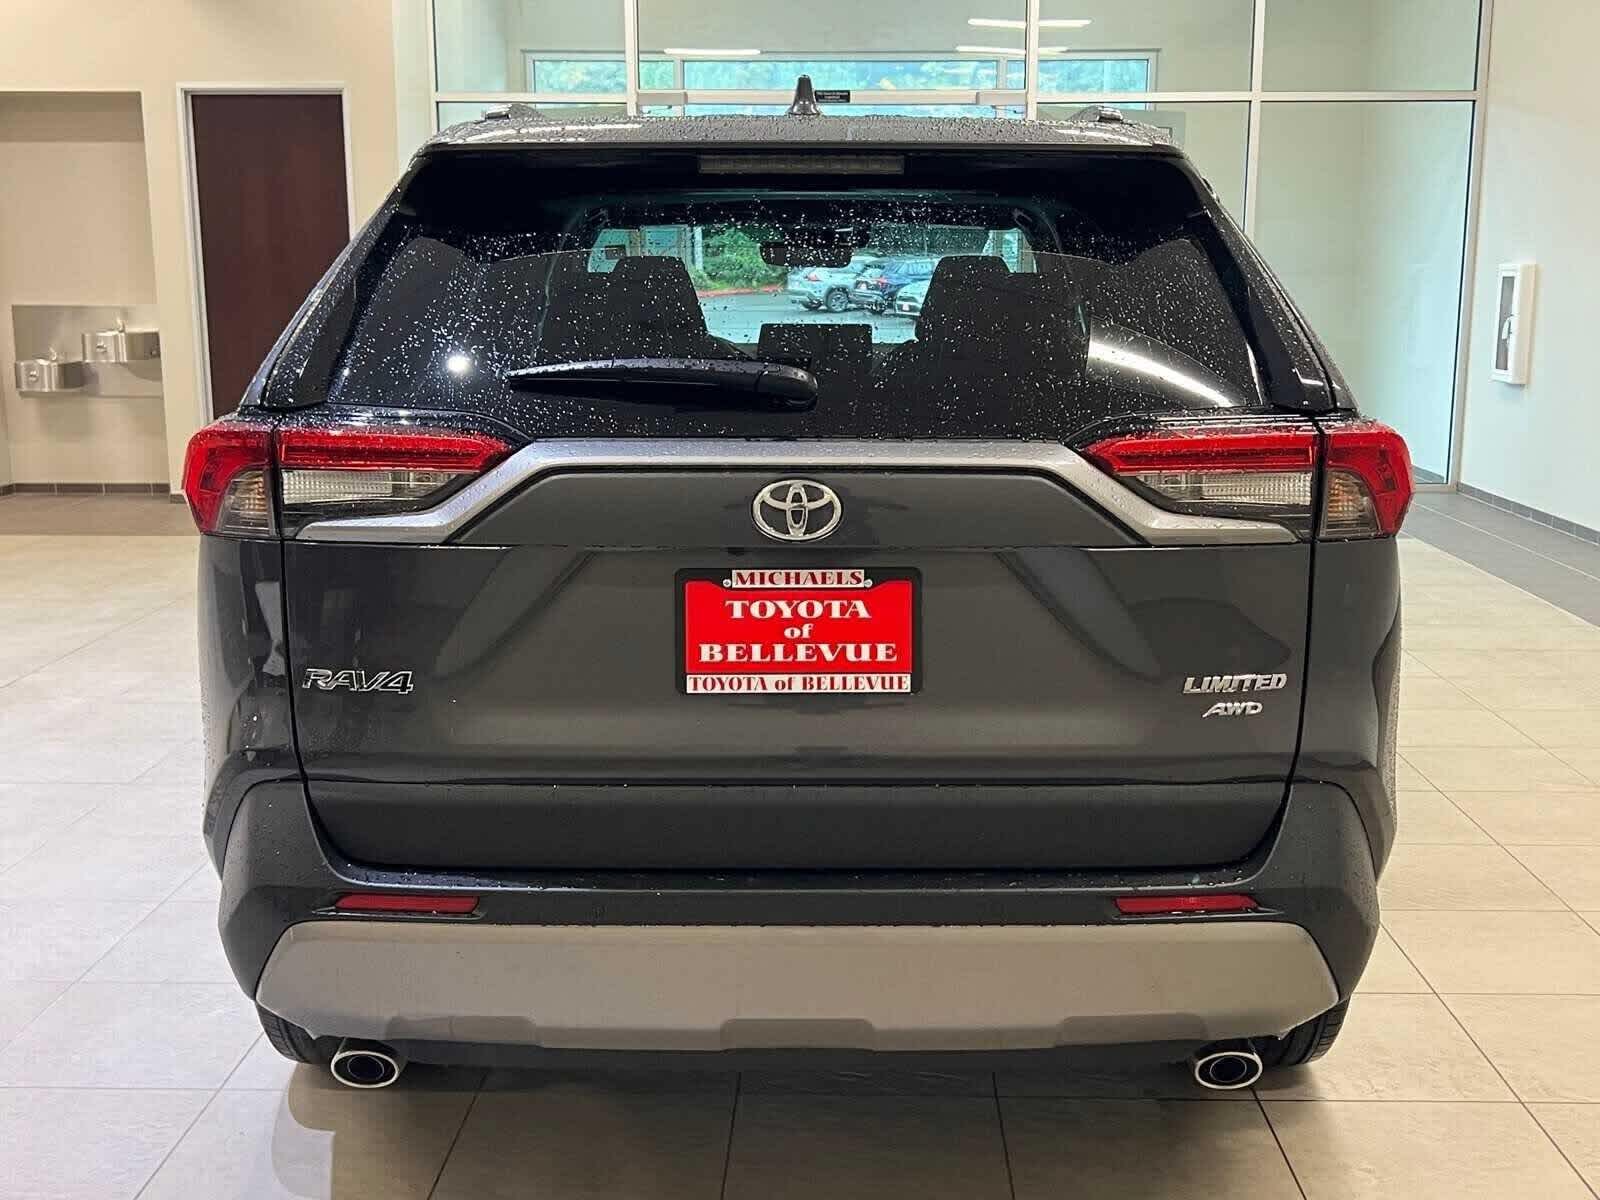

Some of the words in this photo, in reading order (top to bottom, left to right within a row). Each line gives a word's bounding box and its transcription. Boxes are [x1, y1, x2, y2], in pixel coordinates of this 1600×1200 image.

[735, 570, 863, 586] MICHAELS
[725, 600, 872, 619] TOYOTA
[783, 623, 815, 639] of
[698, 643, 898, 662] BELLEVUE
[302, 668, 414, 694] RAV4
[689, 676, 768, 691] TOYOTA
[774, 675, 794, 691] of
[802, 675, 909, 691] BELLEVUE
[1183, 673, 1288, 694] LIMITED
[1202, 701, 1263, 718] AWD
